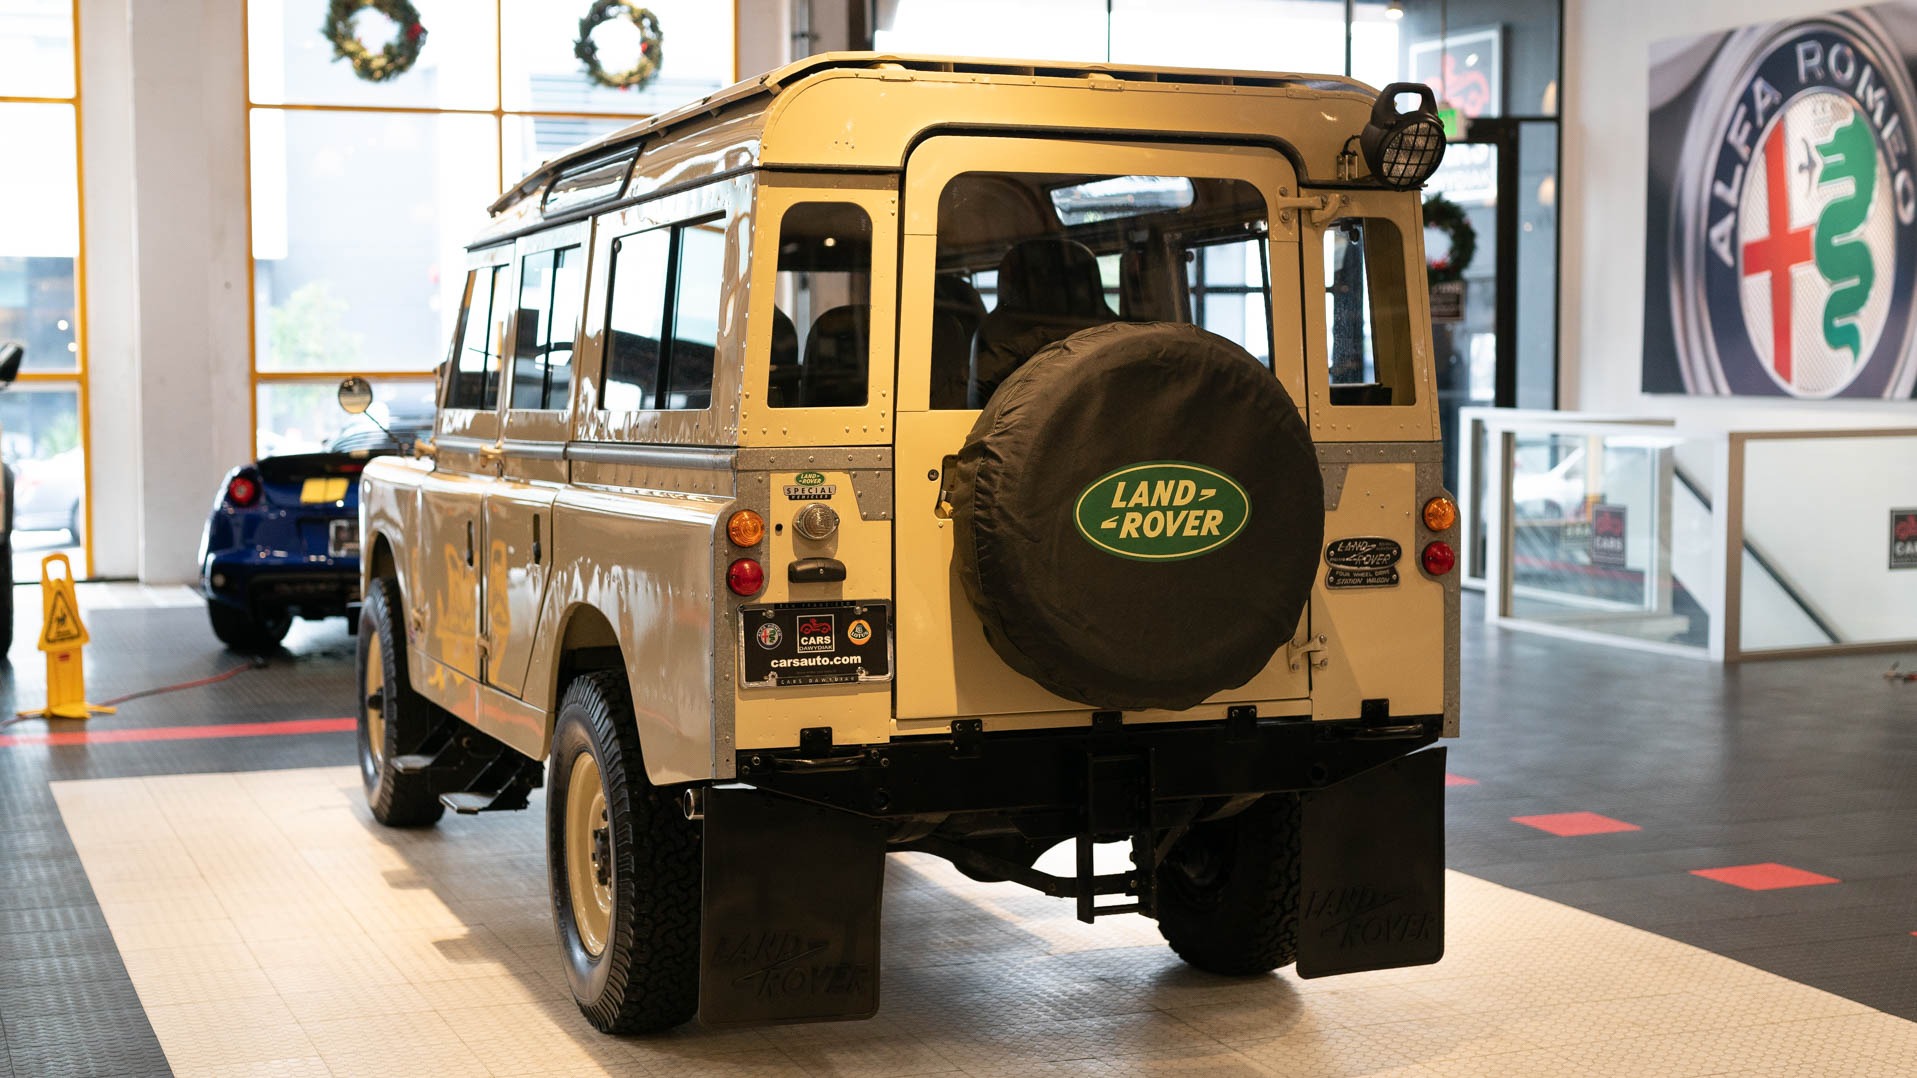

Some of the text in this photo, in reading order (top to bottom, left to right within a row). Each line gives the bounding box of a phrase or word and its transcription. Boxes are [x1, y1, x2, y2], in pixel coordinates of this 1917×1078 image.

[1709, 40, 1916, 268] ALFA ROMEO
[1111, 479, 1197, 509] LAND
[1119, 509, 1224, 539] ROVER
[1337, 541, 1368, 552] LAND
[1354, 553, 1391, 565] ROVER
[800, 635, 831, 645] CARS
[770, 653, 862, 668] carsauto.com
